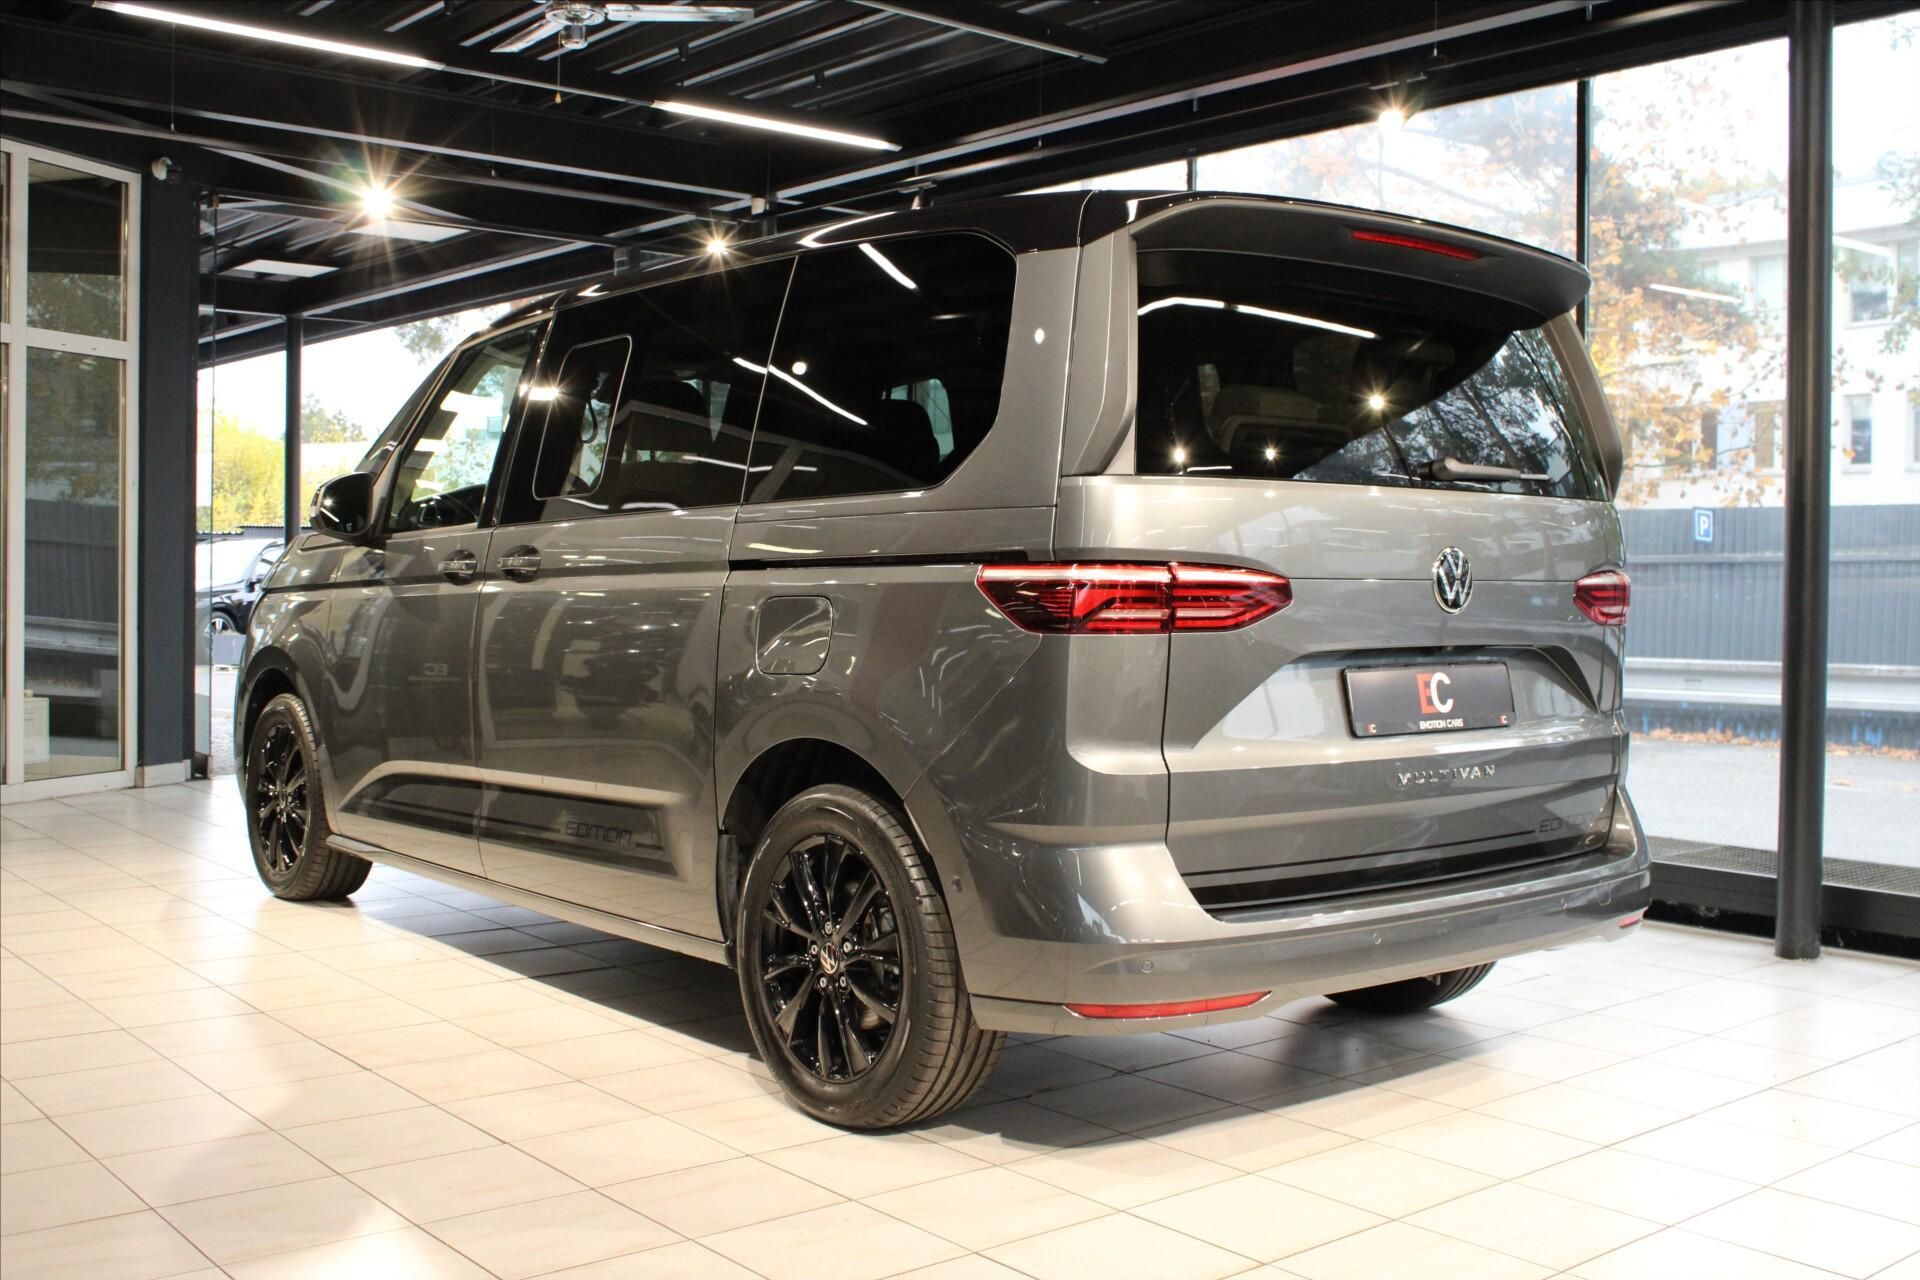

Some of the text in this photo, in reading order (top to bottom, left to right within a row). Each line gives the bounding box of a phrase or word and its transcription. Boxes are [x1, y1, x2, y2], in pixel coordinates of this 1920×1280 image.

[1699, 515, 1709, 536] P
[1416, 672, 1454, 714] EC
[1419, 718, 1464, 729] EMOTION CARS
[1398, 764, 1496, 786] MULTIVAN
